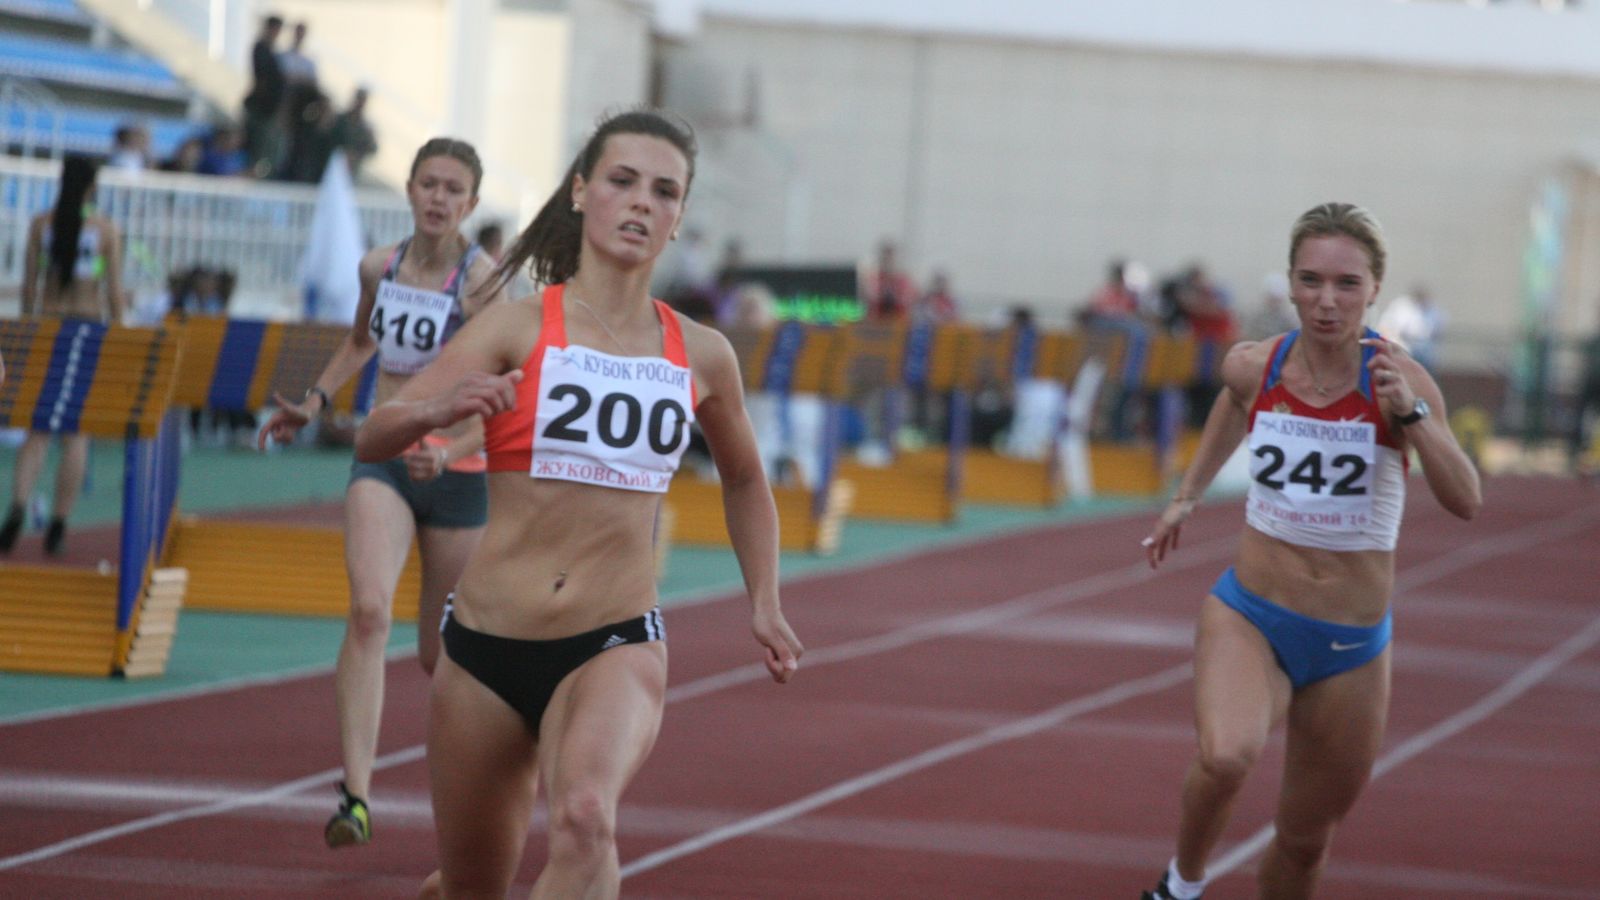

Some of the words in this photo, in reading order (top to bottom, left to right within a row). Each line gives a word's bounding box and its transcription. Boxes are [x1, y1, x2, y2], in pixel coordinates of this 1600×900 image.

[370, 306, 436, 351] 419
[584, 353, 632, 381] КУБОК
[542, 383, 687, 456] 200
[536, 460, 651, 488] ЖУКОВСКИЙ
[1255, 444, 1367, 496] 242
